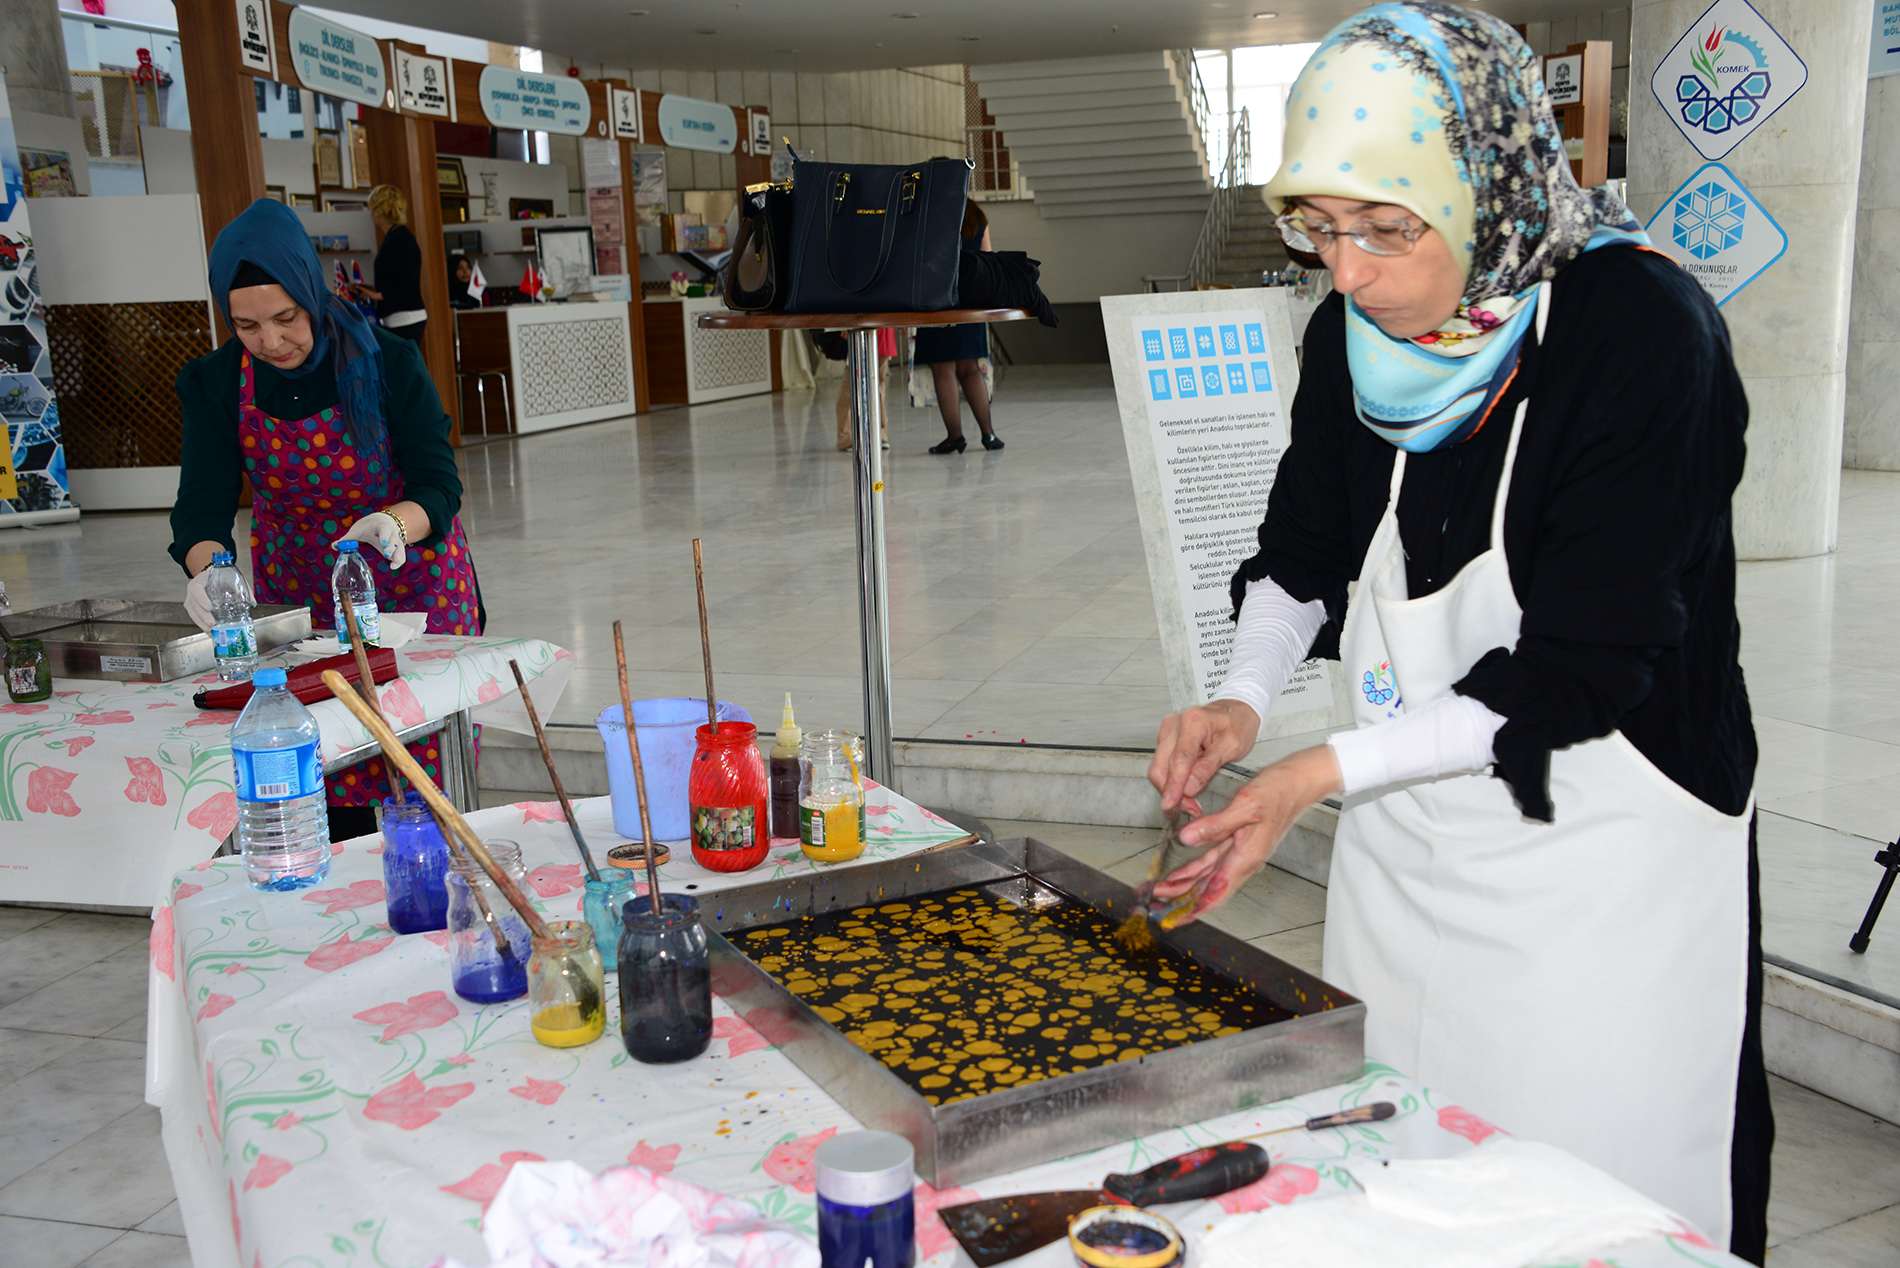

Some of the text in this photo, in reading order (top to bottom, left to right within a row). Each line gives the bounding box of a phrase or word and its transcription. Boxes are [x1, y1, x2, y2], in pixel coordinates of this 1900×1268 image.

[1689, 264, 1738, 274] DOKUNUŞLAR
[1159, 418, 1193, 428] Geleneksel
[1201, 416, 1227, 424] sanatları
[1236, 413, 1256, 421] işlenen
[1167, 422, 1272, 436] kilimlerin yeri Anadolu topraklarıdır.
[1177, 445, 1203, 454] Özellikle
[1222, 442, 1233, 450] halı
[1241, 439, 1269, 449] giysilerde
[1167, 448, 1280, 465] kullanılan figürlerin çoğunluğu yüzyıllar
[1173, 466, 1200, 474] öncesine
[1218, 462, 1230, 470] Dini
[1230, 460, 1245, 468] inanç
[1254, 458, 1278, 466] kültürler
[1179, 474, 1222, 484] doğrultusunda
[1247, 468, 1277, 476] ürünlerine
[1175, 486, 1196, 494] verilen
[1197, 484, 1222, 492] figürler;
[1241, 480, 1262, 488] kaplan,
[1187, 492, 1228, 503] sembollerden
[1228, 491, 1248, 499] oluşur.
[1182, 506, 1194, 514] halı
[1195, 504, 1220, 512] motifleri
[1179, 515, 1207, 524] temsilcisi
[1184, 533, 1208, 541] Halılara
[1210, 529, 1240, 538] uygulanan
[1180, 544, 1194, 553] göre
[1196, 540, 1224, 550] değişiklik
[1208, 550, 1227, 558] reddin
[1190, 560, 1224, 570] Selçuklular
[1198, 572, 1220, 580] işlenen
[1193, 580, 1222, 590] kültürünü
[1195, 608, 1219, 618] Anadolu
[1201, 630, 1213, 638] aynı
[1199, 640, 1225, 648] amacıyla
[1201, 650, 1219, 658] içinde
